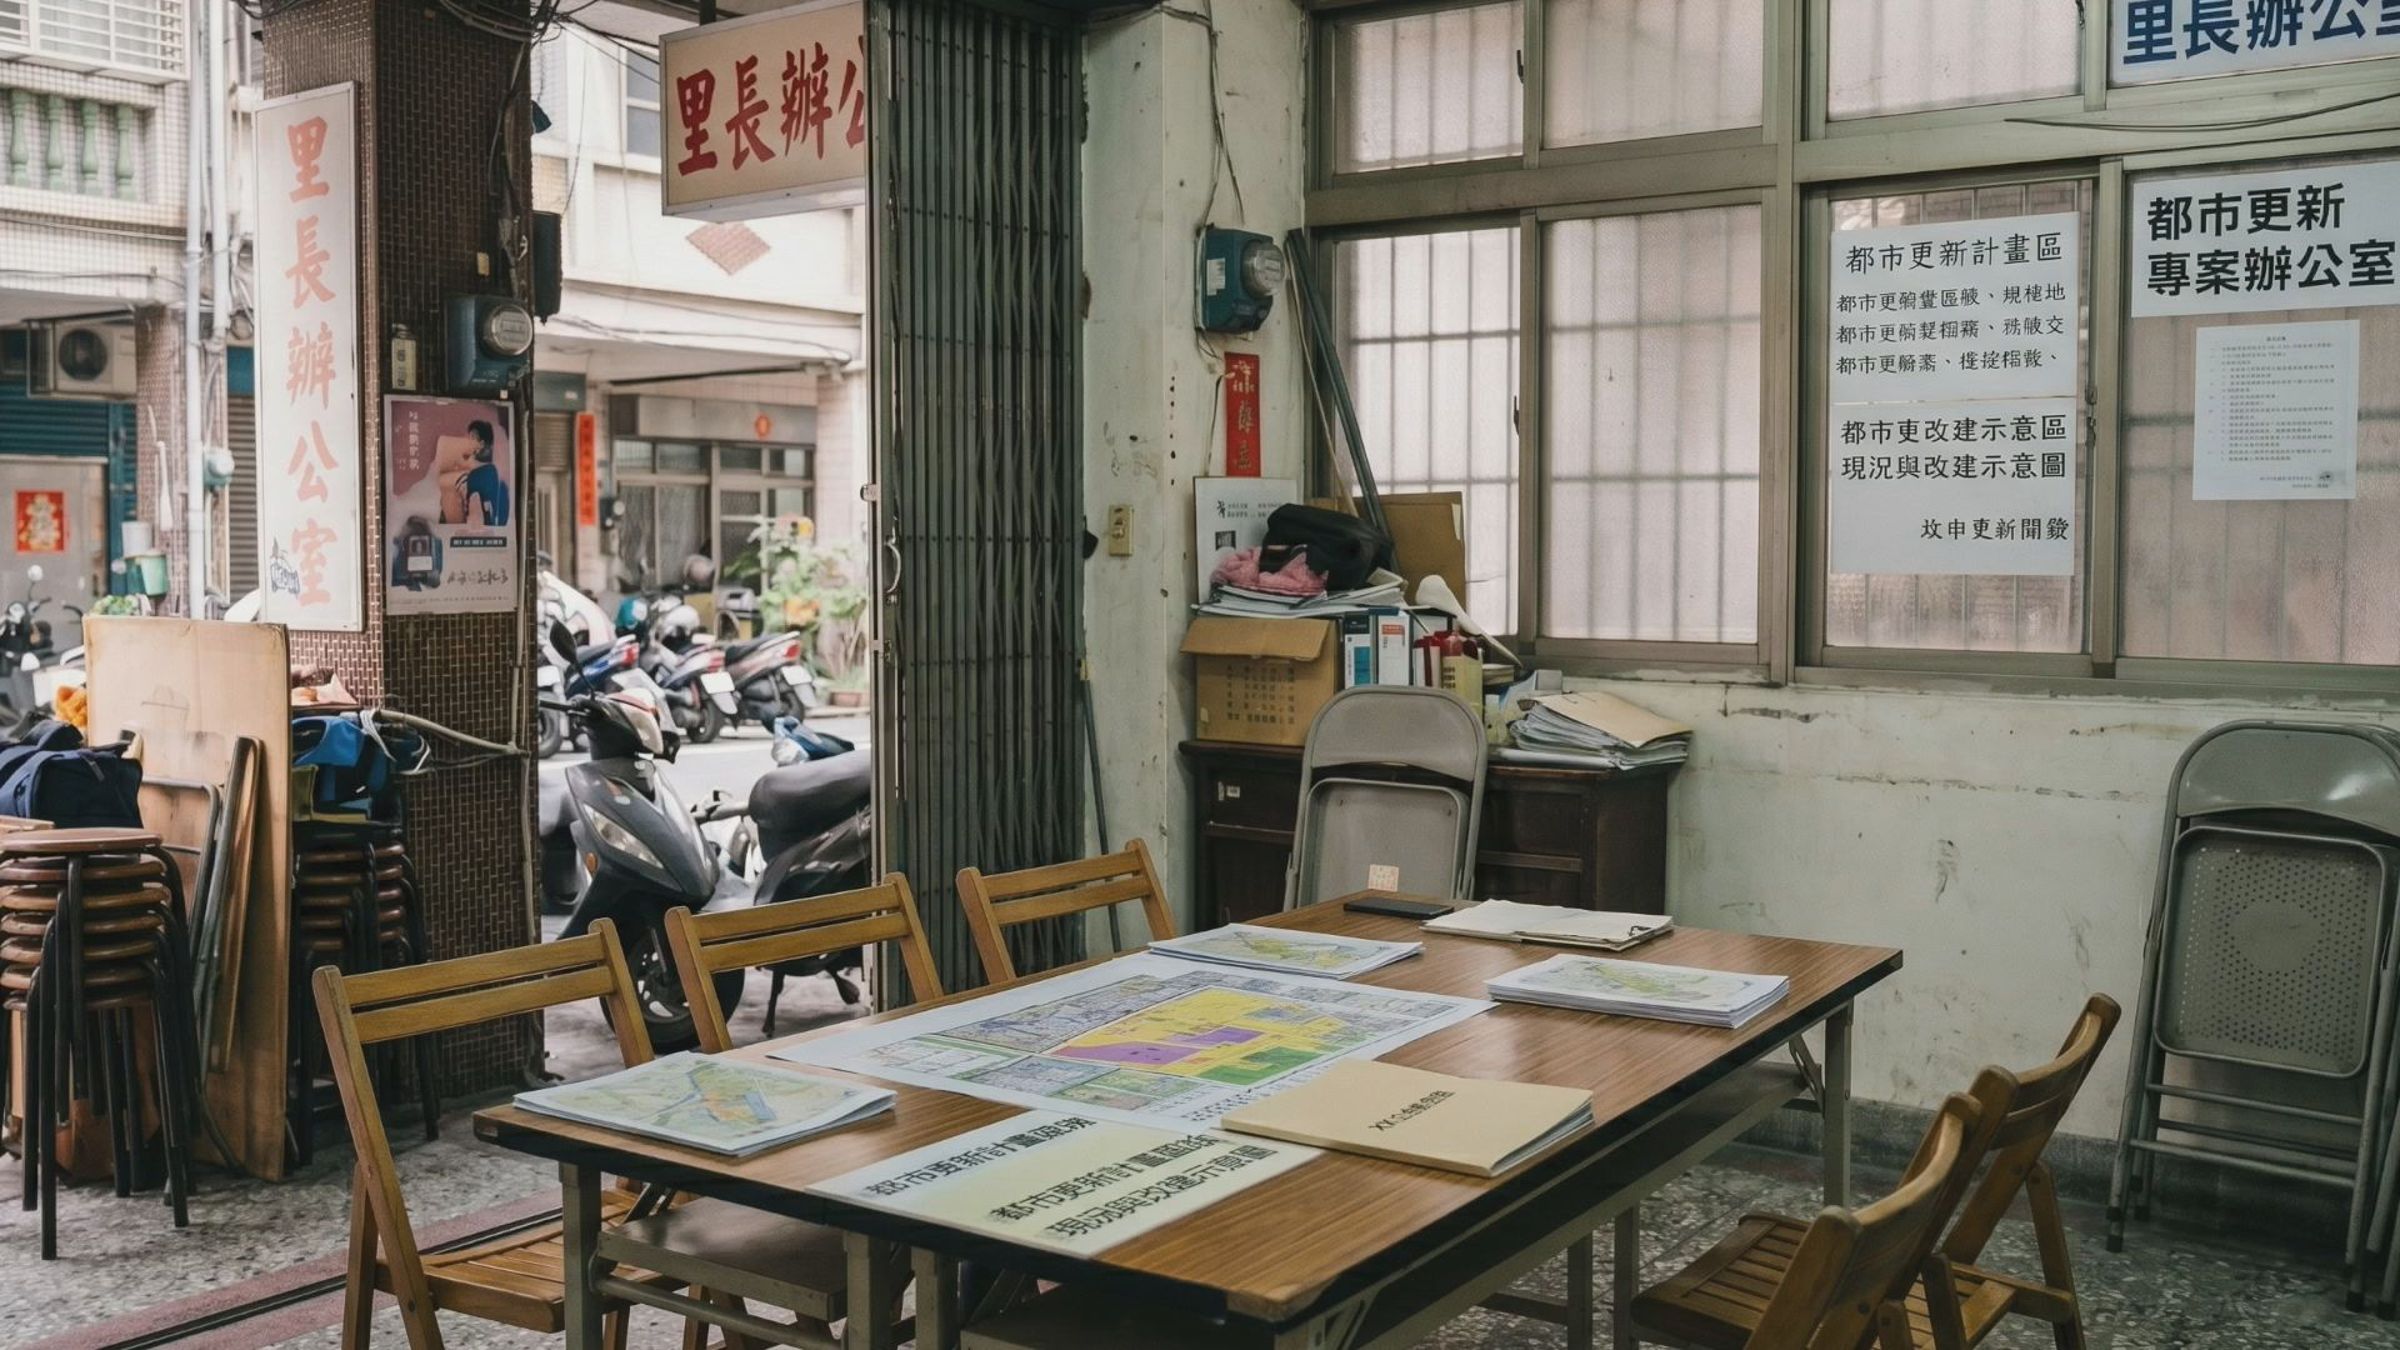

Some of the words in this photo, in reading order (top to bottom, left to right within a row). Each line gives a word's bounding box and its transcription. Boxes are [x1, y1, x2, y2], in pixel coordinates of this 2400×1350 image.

[2147, 182, 2346, 241] 都市更新
[1845, 232, 2062, 275] 都市更新計畫區
[2147, 239, 2396, 297] 專案辦公室
[285, 115, 340, 606] 里長辦公室
[1840, 452, 2066, 480] 現況與改建示意圖
